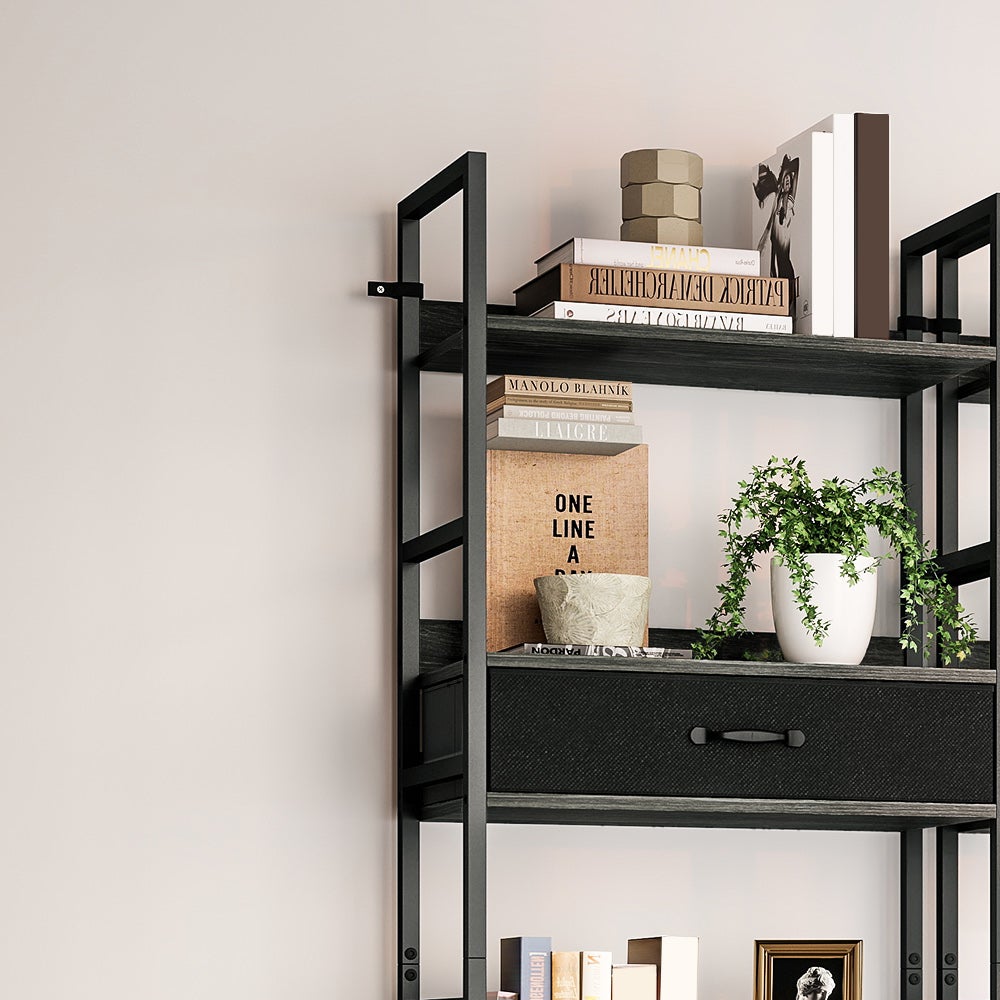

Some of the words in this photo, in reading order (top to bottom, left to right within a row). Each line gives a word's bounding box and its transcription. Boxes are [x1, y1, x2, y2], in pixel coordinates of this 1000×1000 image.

[508, 378, 570, 394] MANOLO
[574, 382, 629, 396] BLAHNÍK
[518, 410, 549, 419] POLLOCK
[550, 412, 579, 421] BEYOND
[580, 413, 611, 422] PAINTING
[535, 421, 608, 441] LIAIGRE
[555, 493, 593, 514] ONE
[552, 519, 595, 539] LINE
[567, 545, 579, 563] A
[531, 646, 581, 656] PARDON
